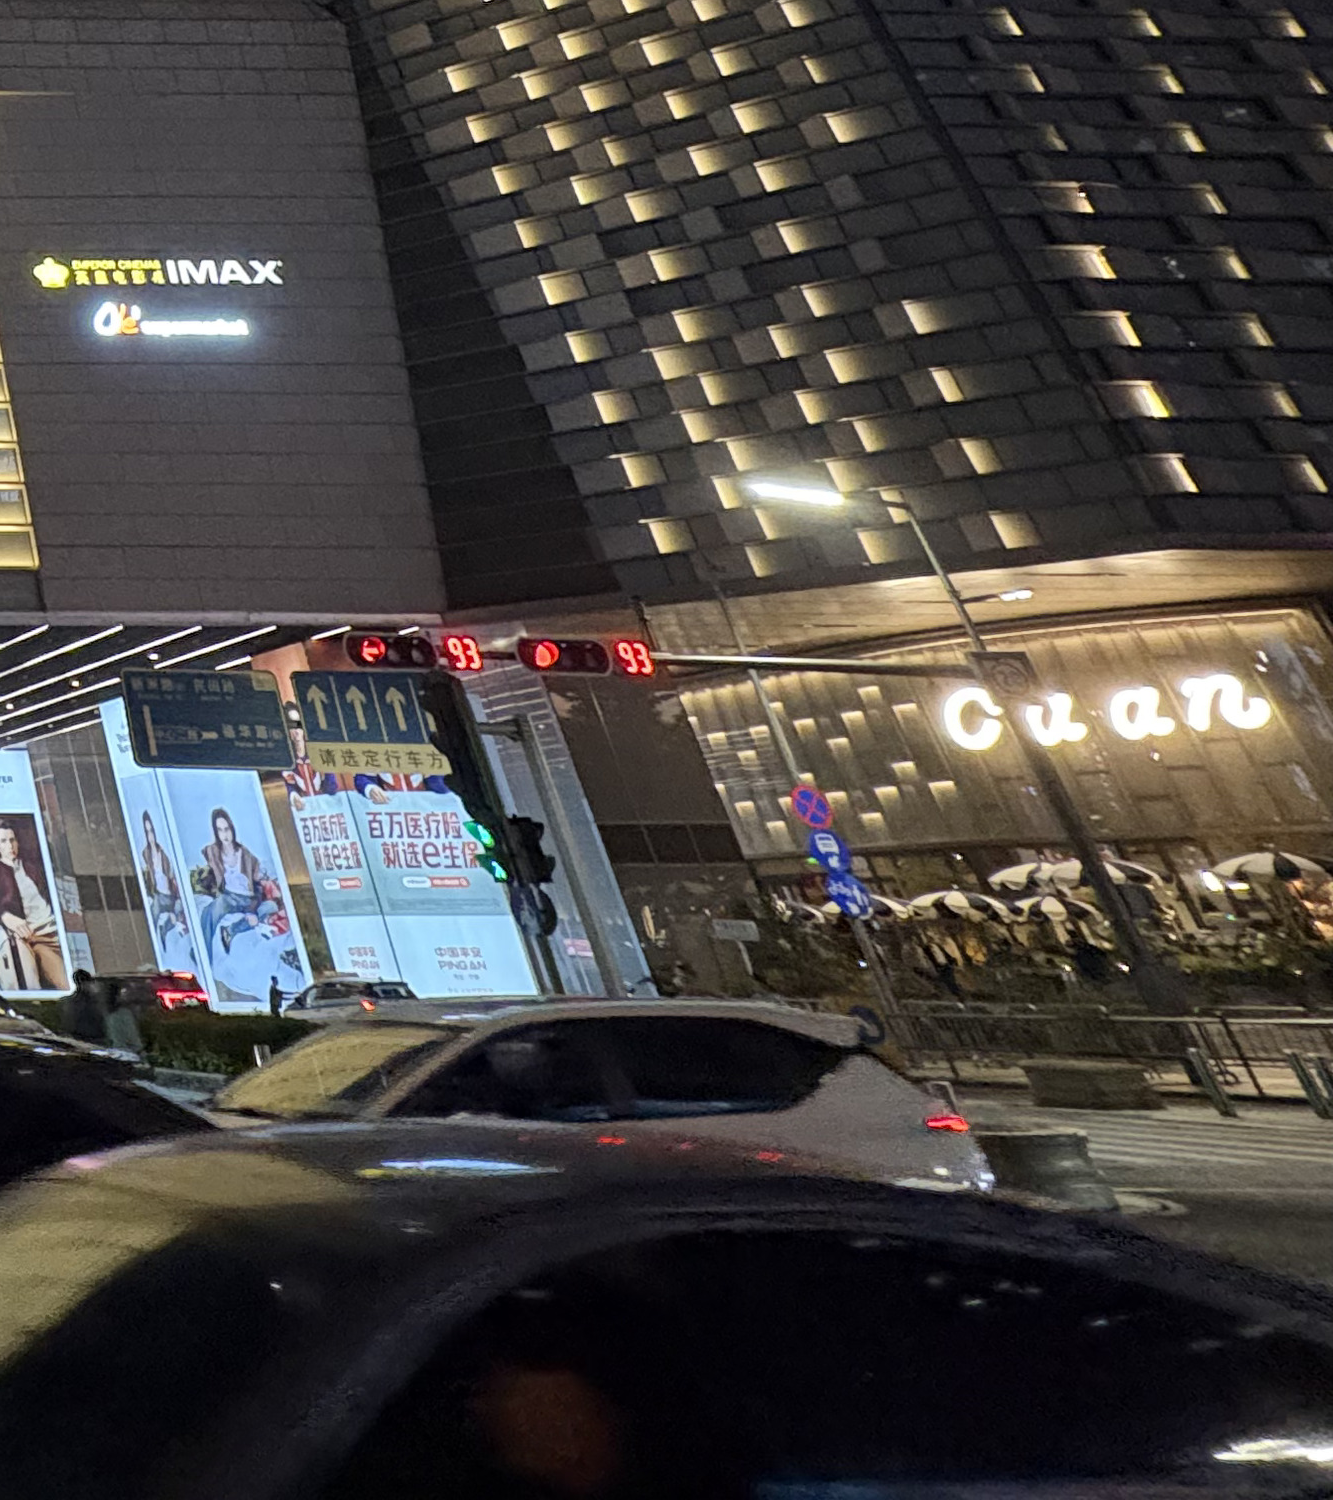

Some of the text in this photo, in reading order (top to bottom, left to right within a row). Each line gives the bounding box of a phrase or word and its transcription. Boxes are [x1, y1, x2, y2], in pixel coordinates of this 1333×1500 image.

[165, 259, 283, 285] IMAX
[446, 636, 483, 670] 93
[616, 641, 655, 674] 93
[318, 748, 444, 770] 请选定行车方
[365, 811, 463, 840] 百万医疗险
[381, 841, 480, 870] 就选e生保
